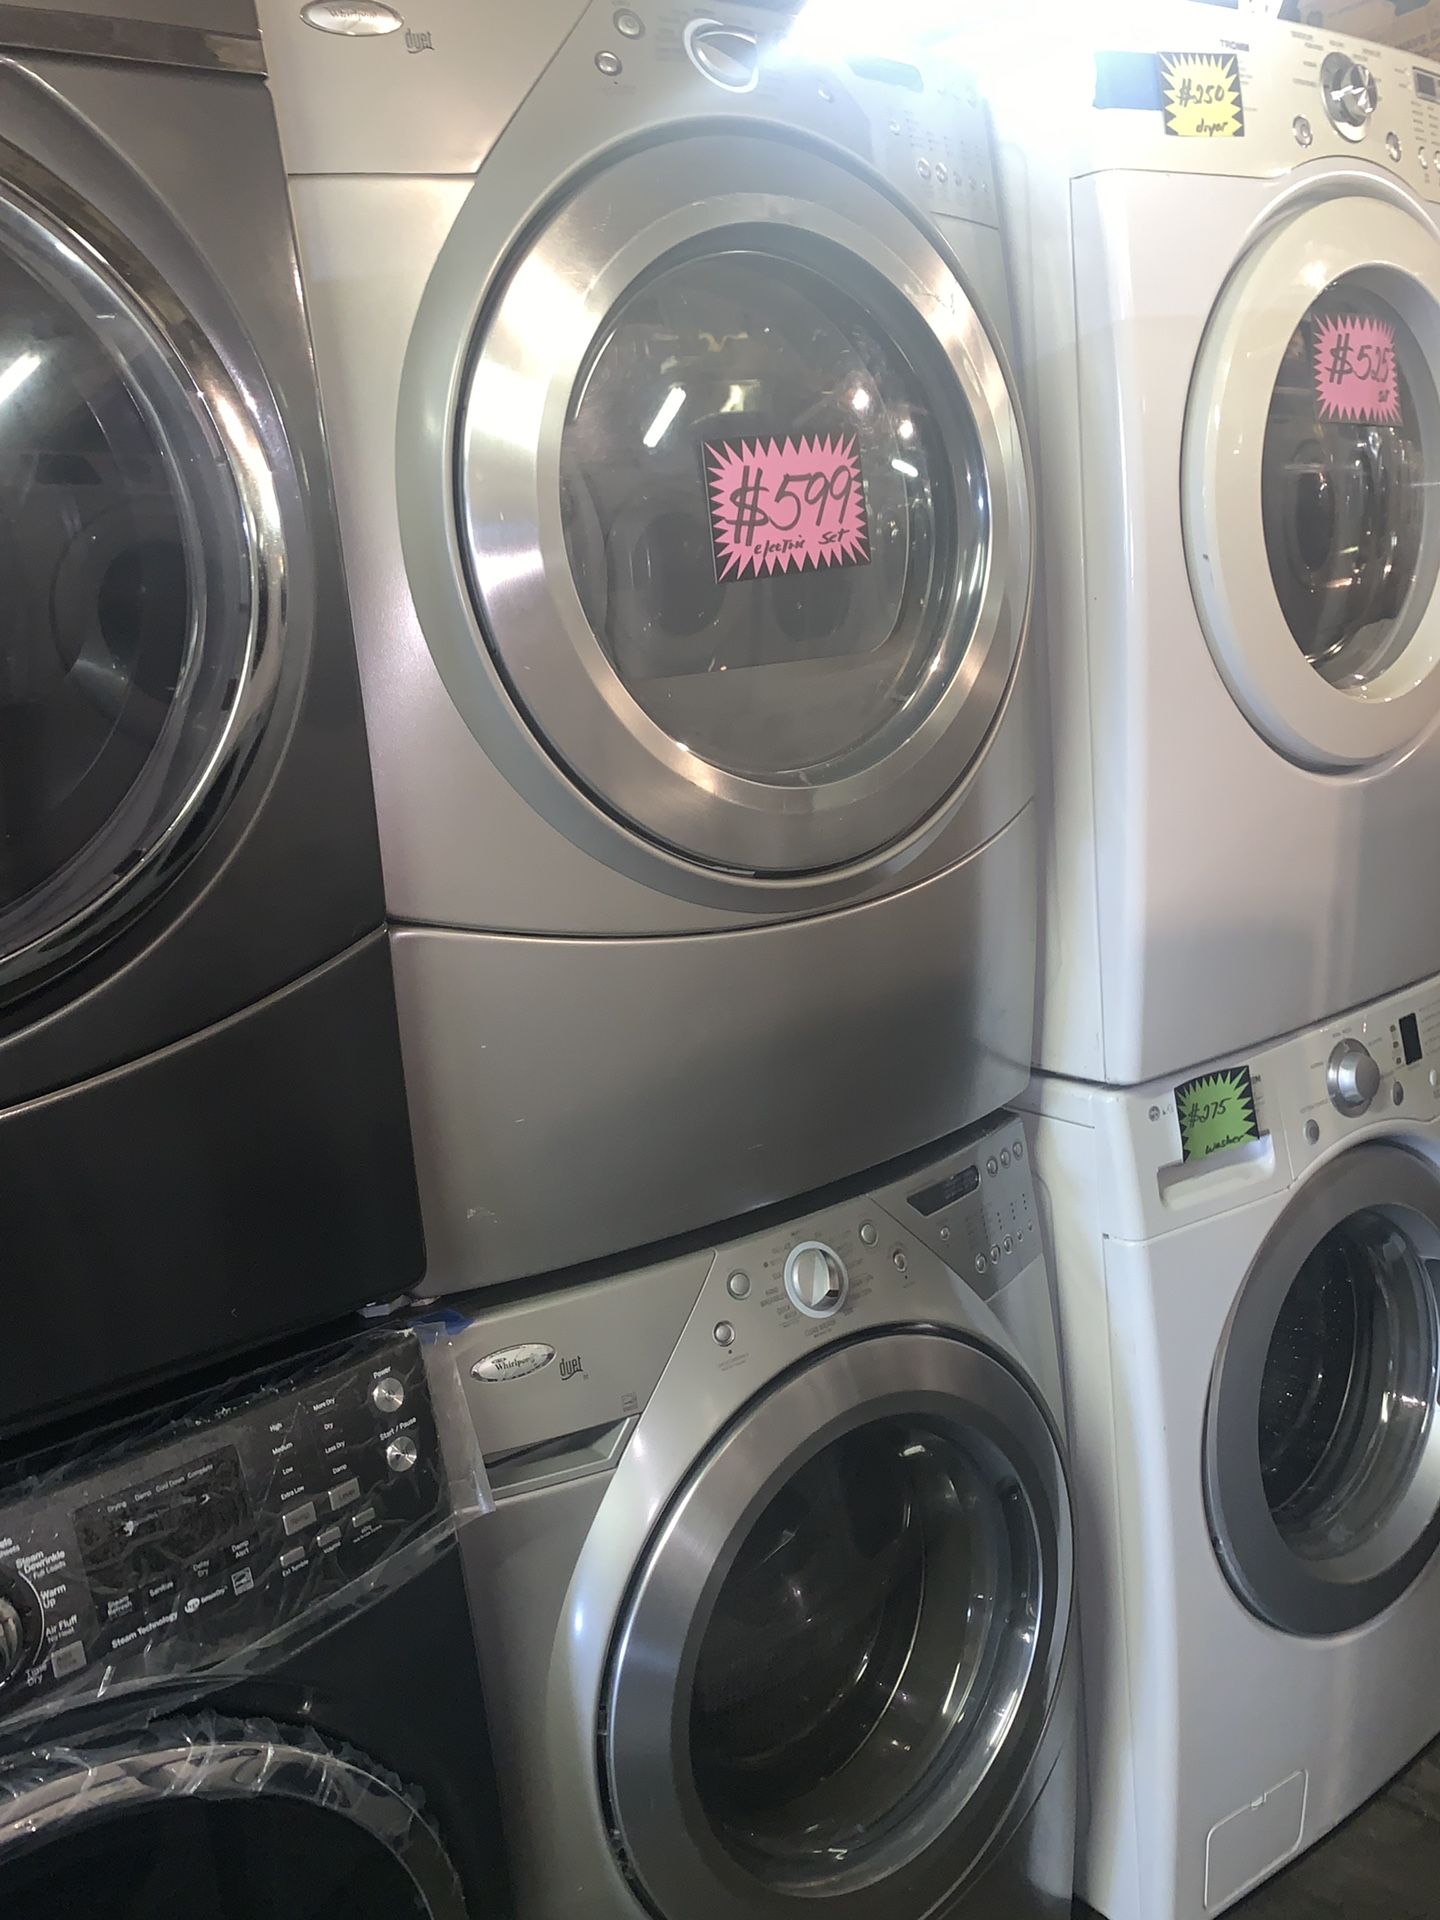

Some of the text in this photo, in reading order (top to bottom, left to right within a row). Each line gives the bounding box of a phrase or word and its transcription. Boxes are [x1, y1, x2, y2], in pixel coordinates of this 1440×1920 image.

[405, 28, 435, 54] duet
[1176, 78, 1225, 108] $250
[1195, 117, 1229, 137] dryer
[725, 465, 852, 546] $599
[1188, 1096, 1233, 1129] $275
[1204, 1134, 1246, 1155] washer
[373, 1365, 392, 1379] Power
[559, 1355, 584, 1381] duet
[312, 1397, 336, 1411] More Dry
[323, 1422, 334, 1431] Dry
[379, 1427, 395, 1441] Start
[399, 1416, 417, 1430] Pause
[324, 1440, 346, 1454] Less Dry
[282, 1466, 294, 1476] Low
[332, 1464, 348, 1475] Damp
[280, 1485, 305, 1501] Extra Low
[15, 1550, 44, 1569] Steam
[40, 1583, 67, 1601] Warm
[43, 1598, 56, 1610] Up
[45, 1614, 78, 1637] Air Fluff
[111, 1611, 178, 1649] Steam Technology
